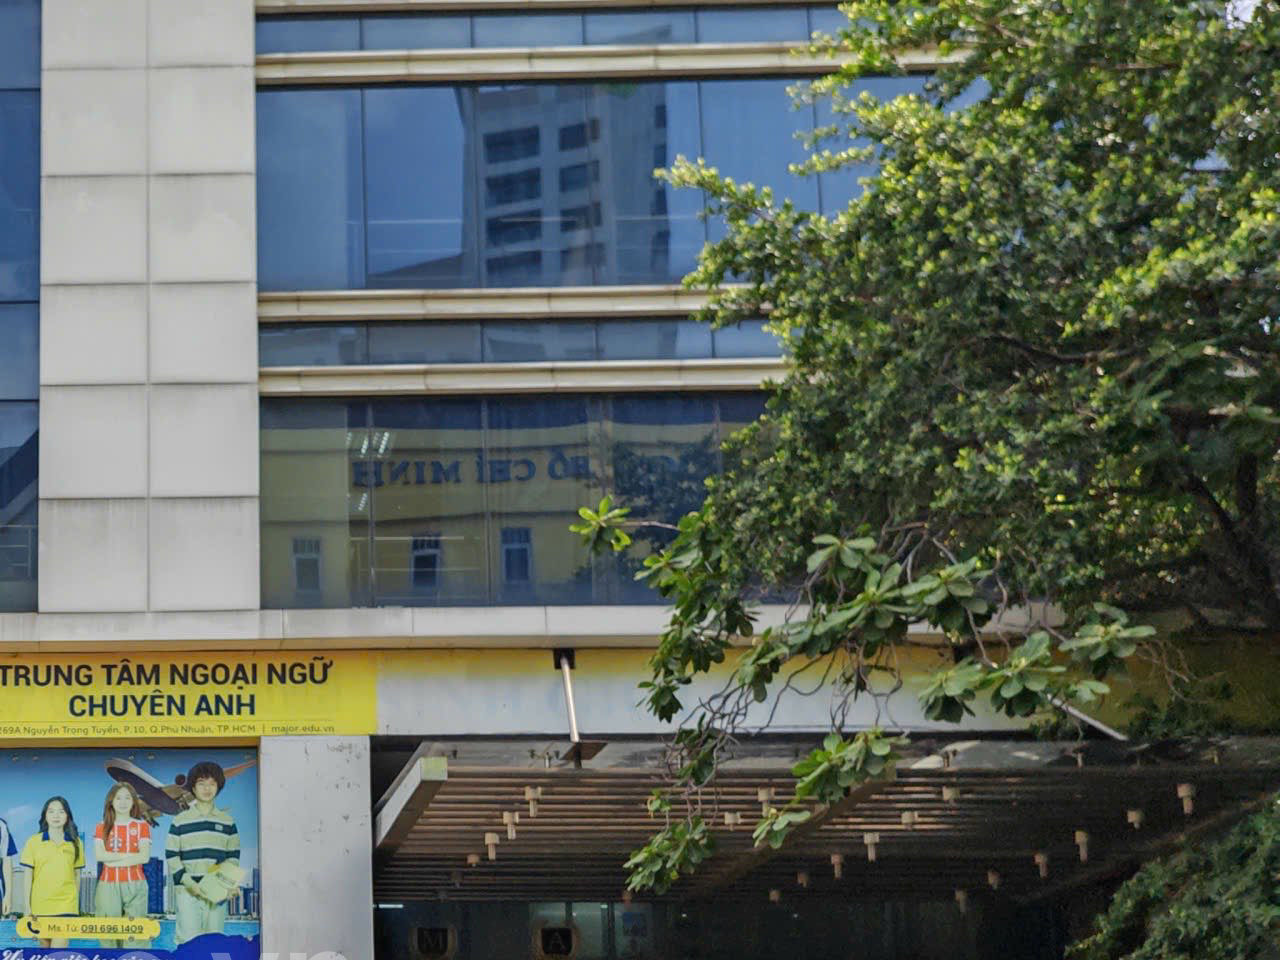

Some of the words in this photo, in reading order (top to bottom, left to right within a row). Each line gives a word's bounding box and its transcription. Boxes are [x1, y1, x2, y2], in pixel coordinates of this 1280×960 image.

[101, 658, 160, 686] TÂM
[169, 663, 257, 690] NGOẠI
[267, 656, 333, 685] NGỮ
[69, 689, 186, 717] CHUYÊN
[194, 694, 256, 716] ANH
[23, 725, 59, 736] Nguyễn
[81, 924, 97, 934] 091
[100, 924, 118, 934] 696
[121, 924, 144, 935] 1409
